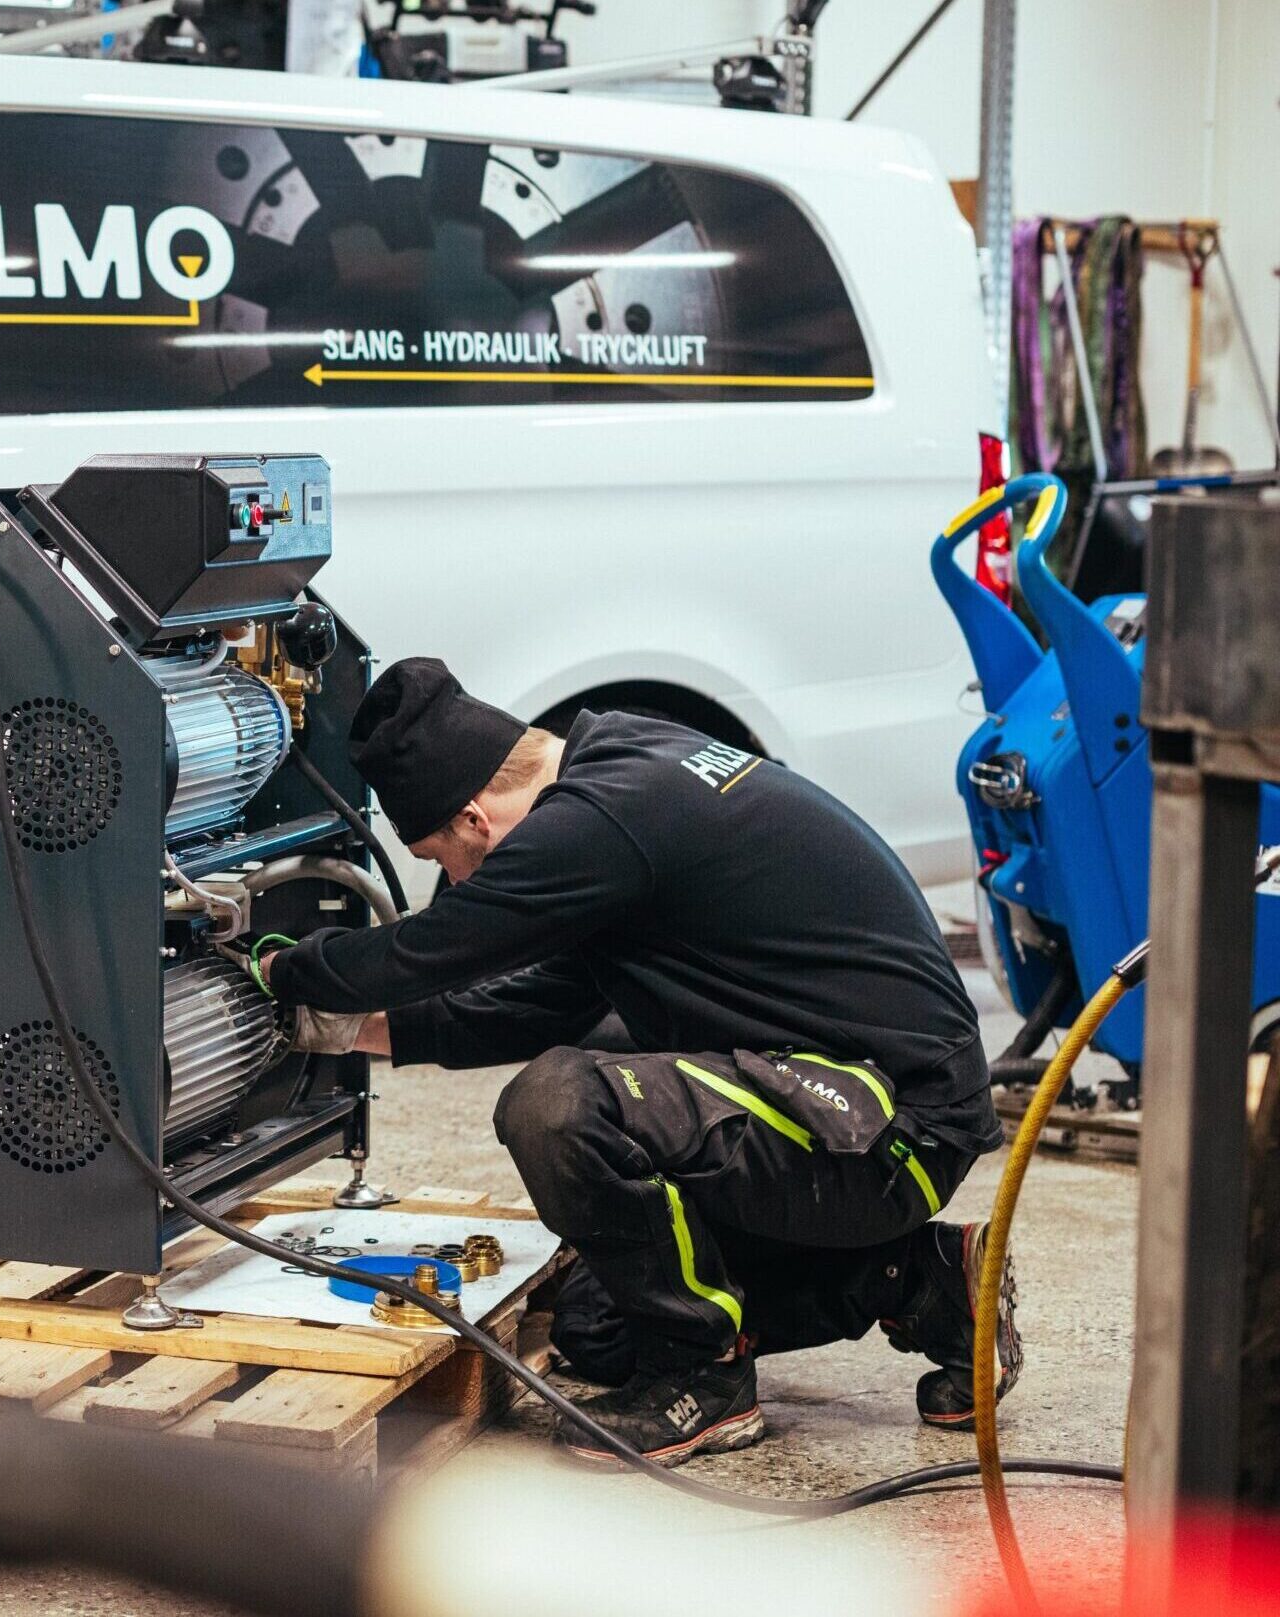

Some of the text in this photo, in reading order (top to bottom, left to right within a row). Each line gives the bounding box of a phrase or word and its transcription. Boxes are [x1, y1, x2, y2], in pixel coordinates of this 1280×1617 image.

[322, 329, 708, 367] SLANG HYDRAULIK TRYCKLUFT
[680, 741, 753, 788] HILL
